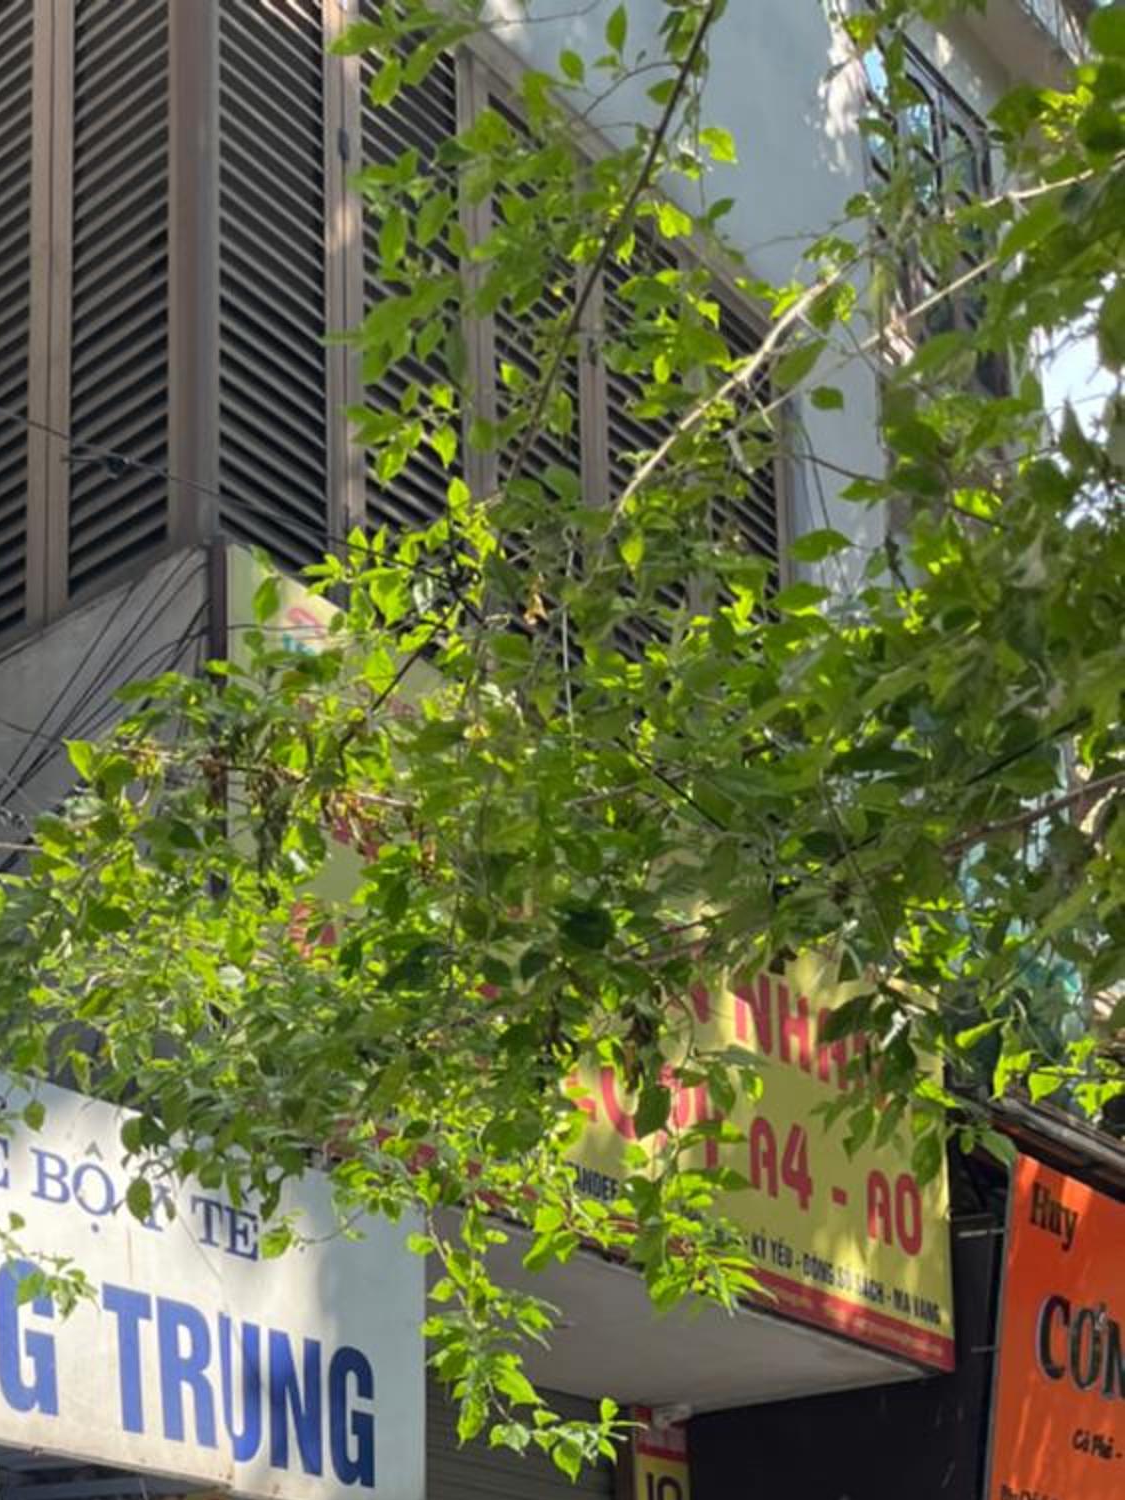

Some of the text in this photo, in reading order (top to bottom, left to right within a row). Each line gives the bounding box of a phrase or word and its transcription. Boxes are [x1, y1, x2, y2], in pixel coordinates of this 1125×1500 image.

[29, 1141, 115, 1233] BỘ
[749, 1116, 813, 1211] A4
[1029, 1181, 1078, 1252] Huy
[102, 1282, 376, 1490] TRUNG
